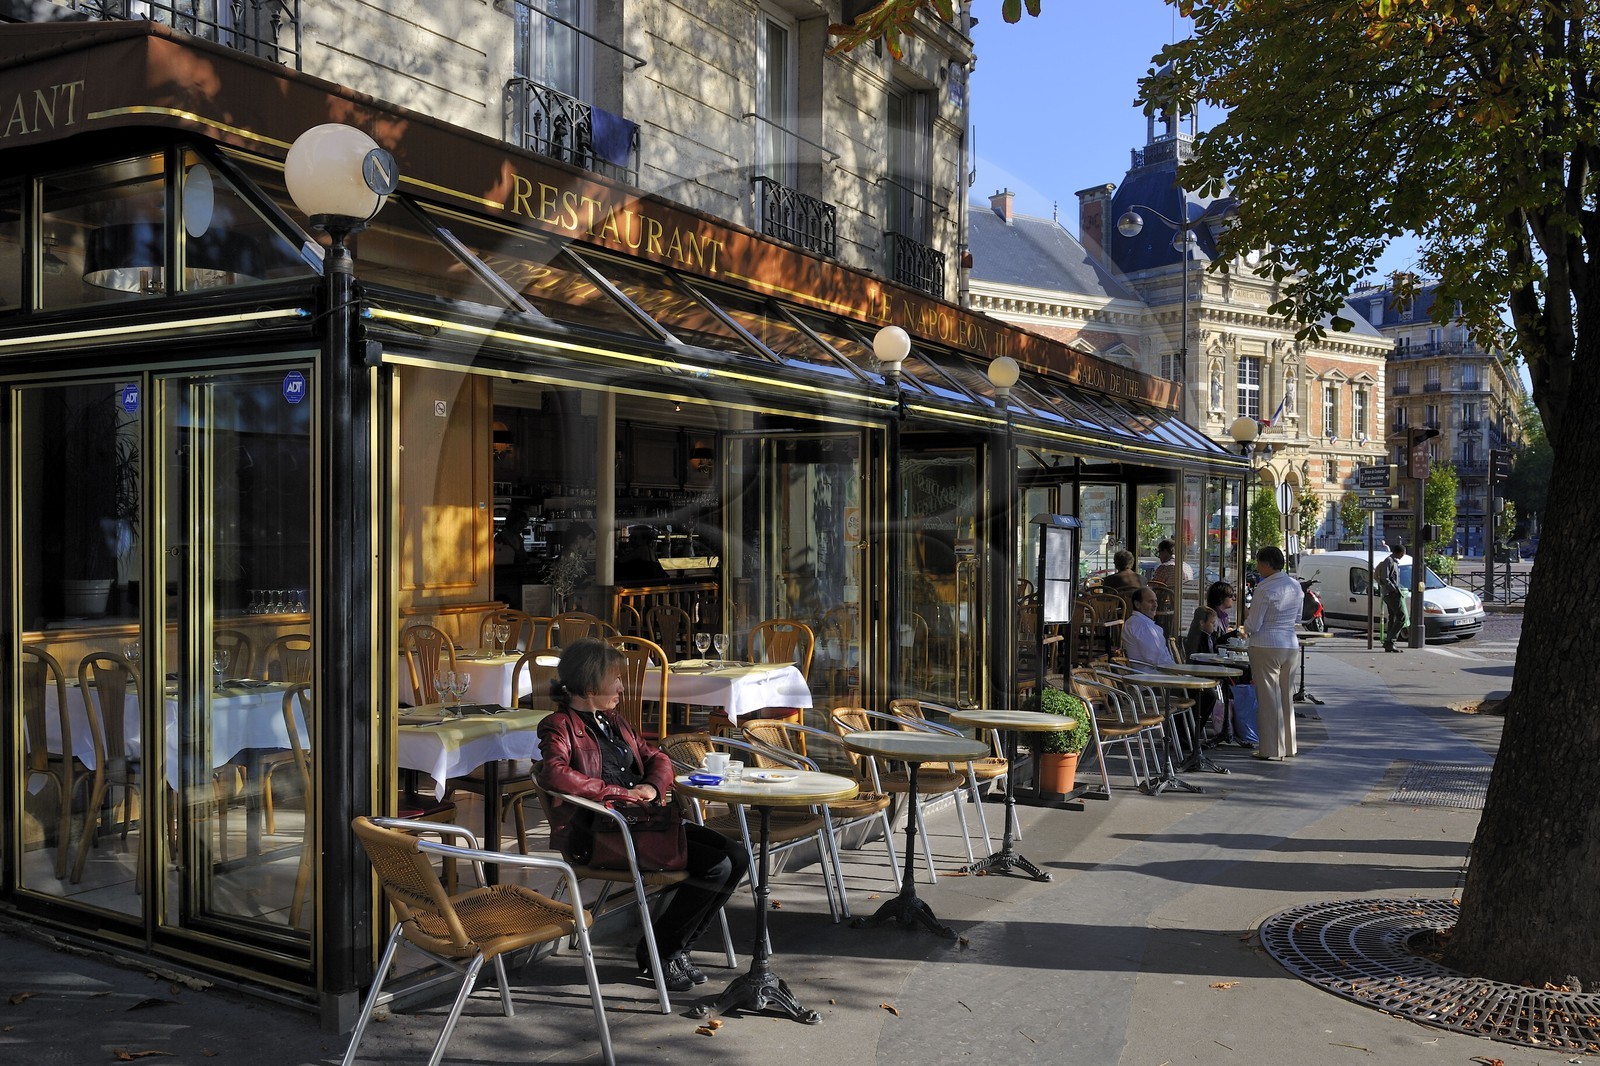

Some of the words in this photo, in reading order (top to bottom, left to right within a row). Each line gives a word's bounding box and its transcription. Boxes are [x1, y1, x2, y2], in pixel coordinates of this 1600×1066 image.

[0, 80, 84, 137] ANT
[510, 173, 723, 273] RESTAURANT
[867, 288, 893, 324] LE
[903, 299, 988, 352] NAPOLEON
[124, 392, 138, 404] ADT
[286, 381, 302, 393] ADT
[1076, 362, 1106, 389] SALON
[1110, 373, 1121, 393] DE
